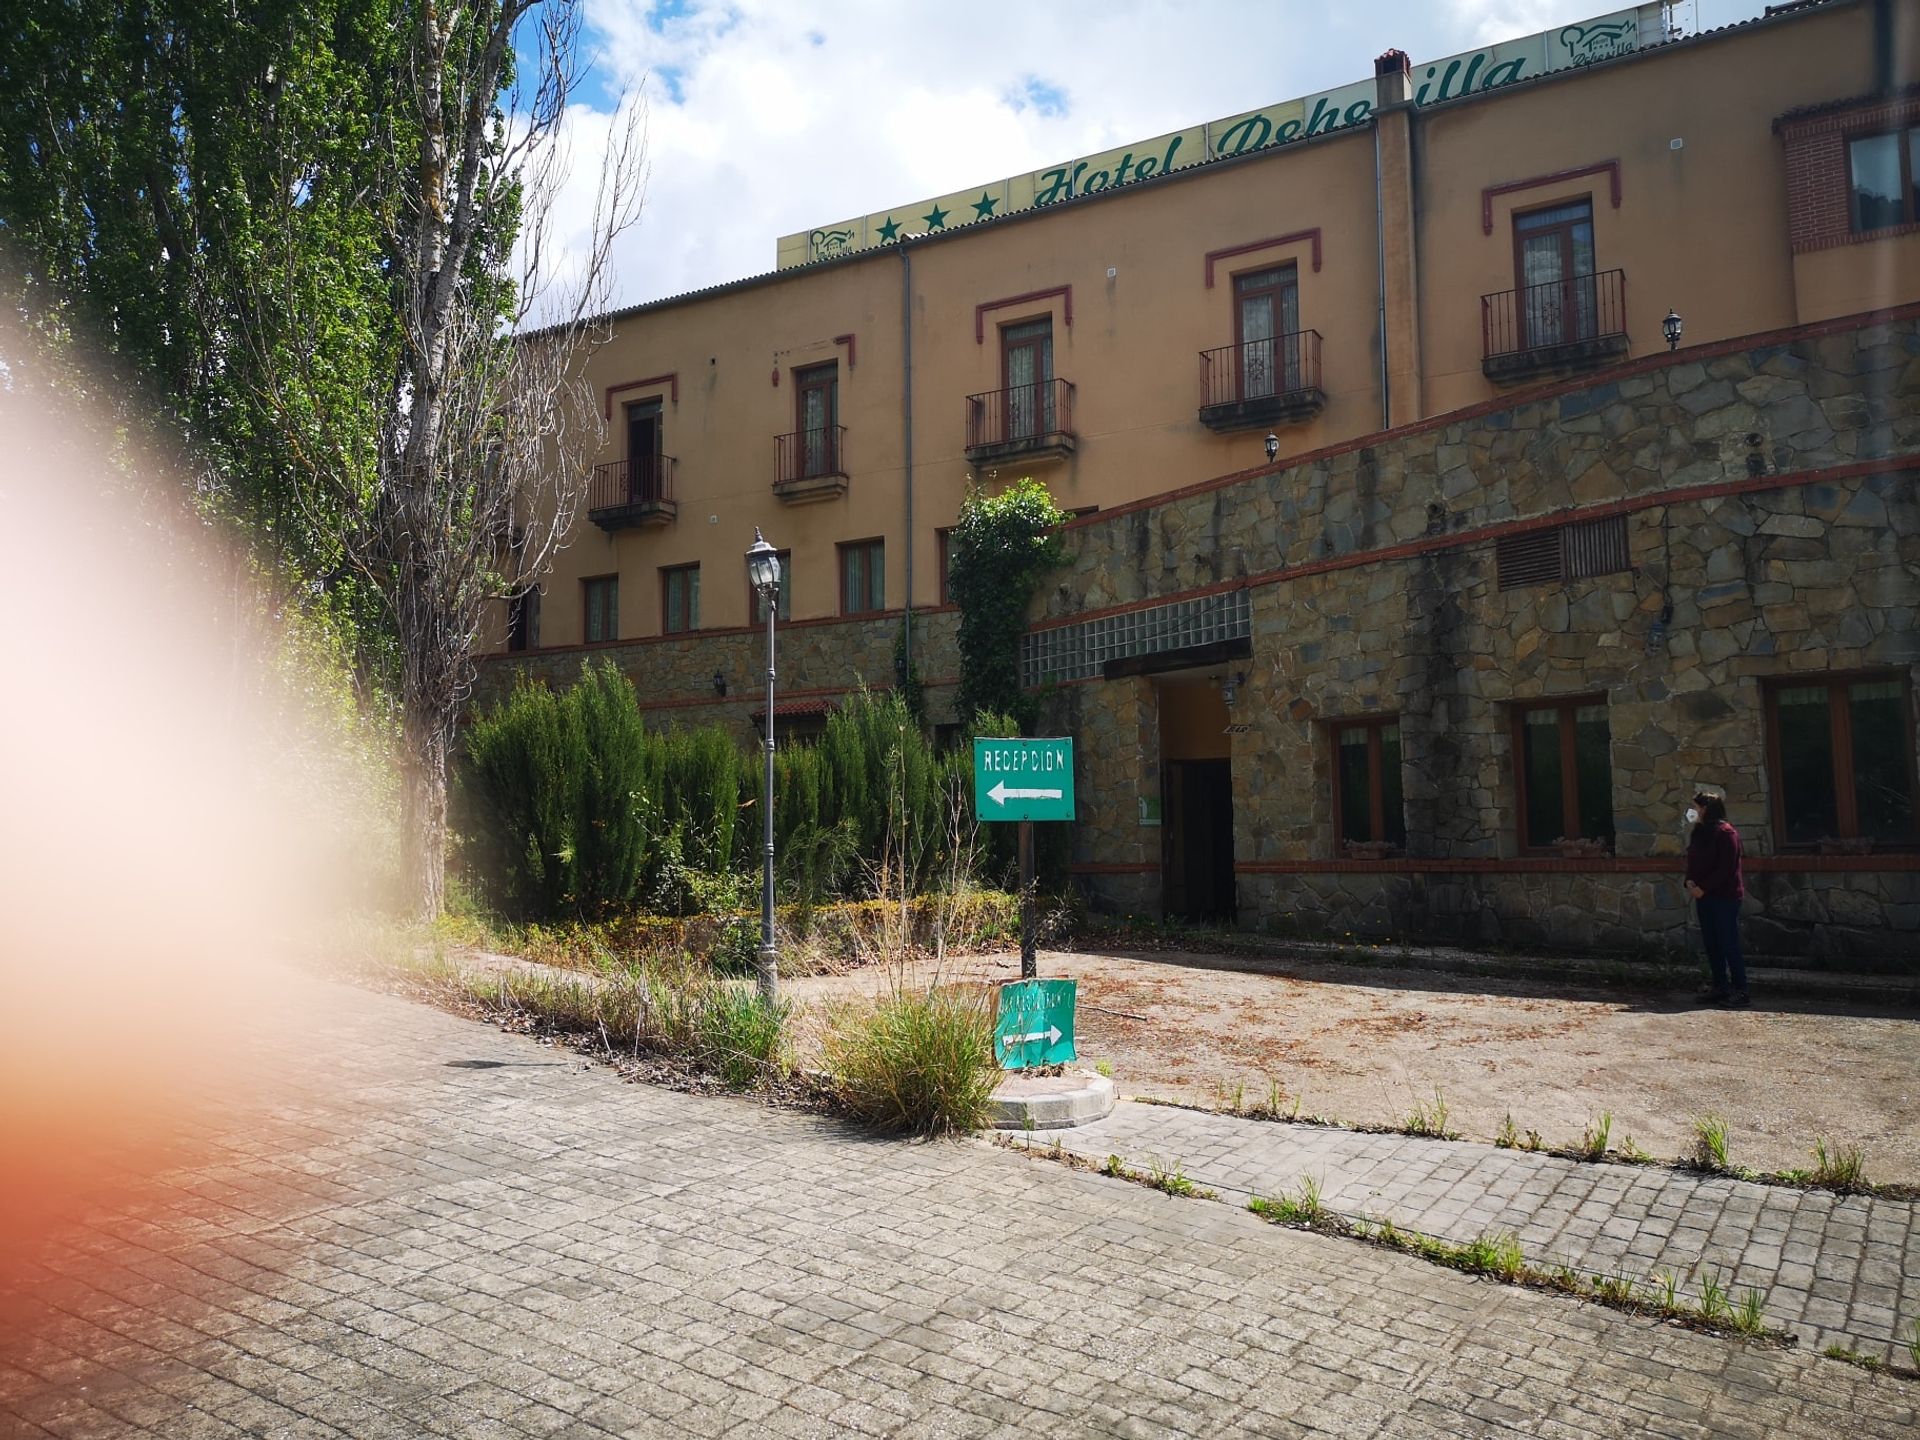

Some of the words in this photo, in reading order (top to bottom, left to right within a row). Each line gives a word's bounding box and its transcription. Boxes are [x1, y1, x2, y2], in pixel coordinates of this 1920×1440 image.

[1034, 136, 1183, 207] Hotel
[1217, 53, 1527, 153] Deheilla
[984, 744, 1064, 771] RECEPCIÓN
